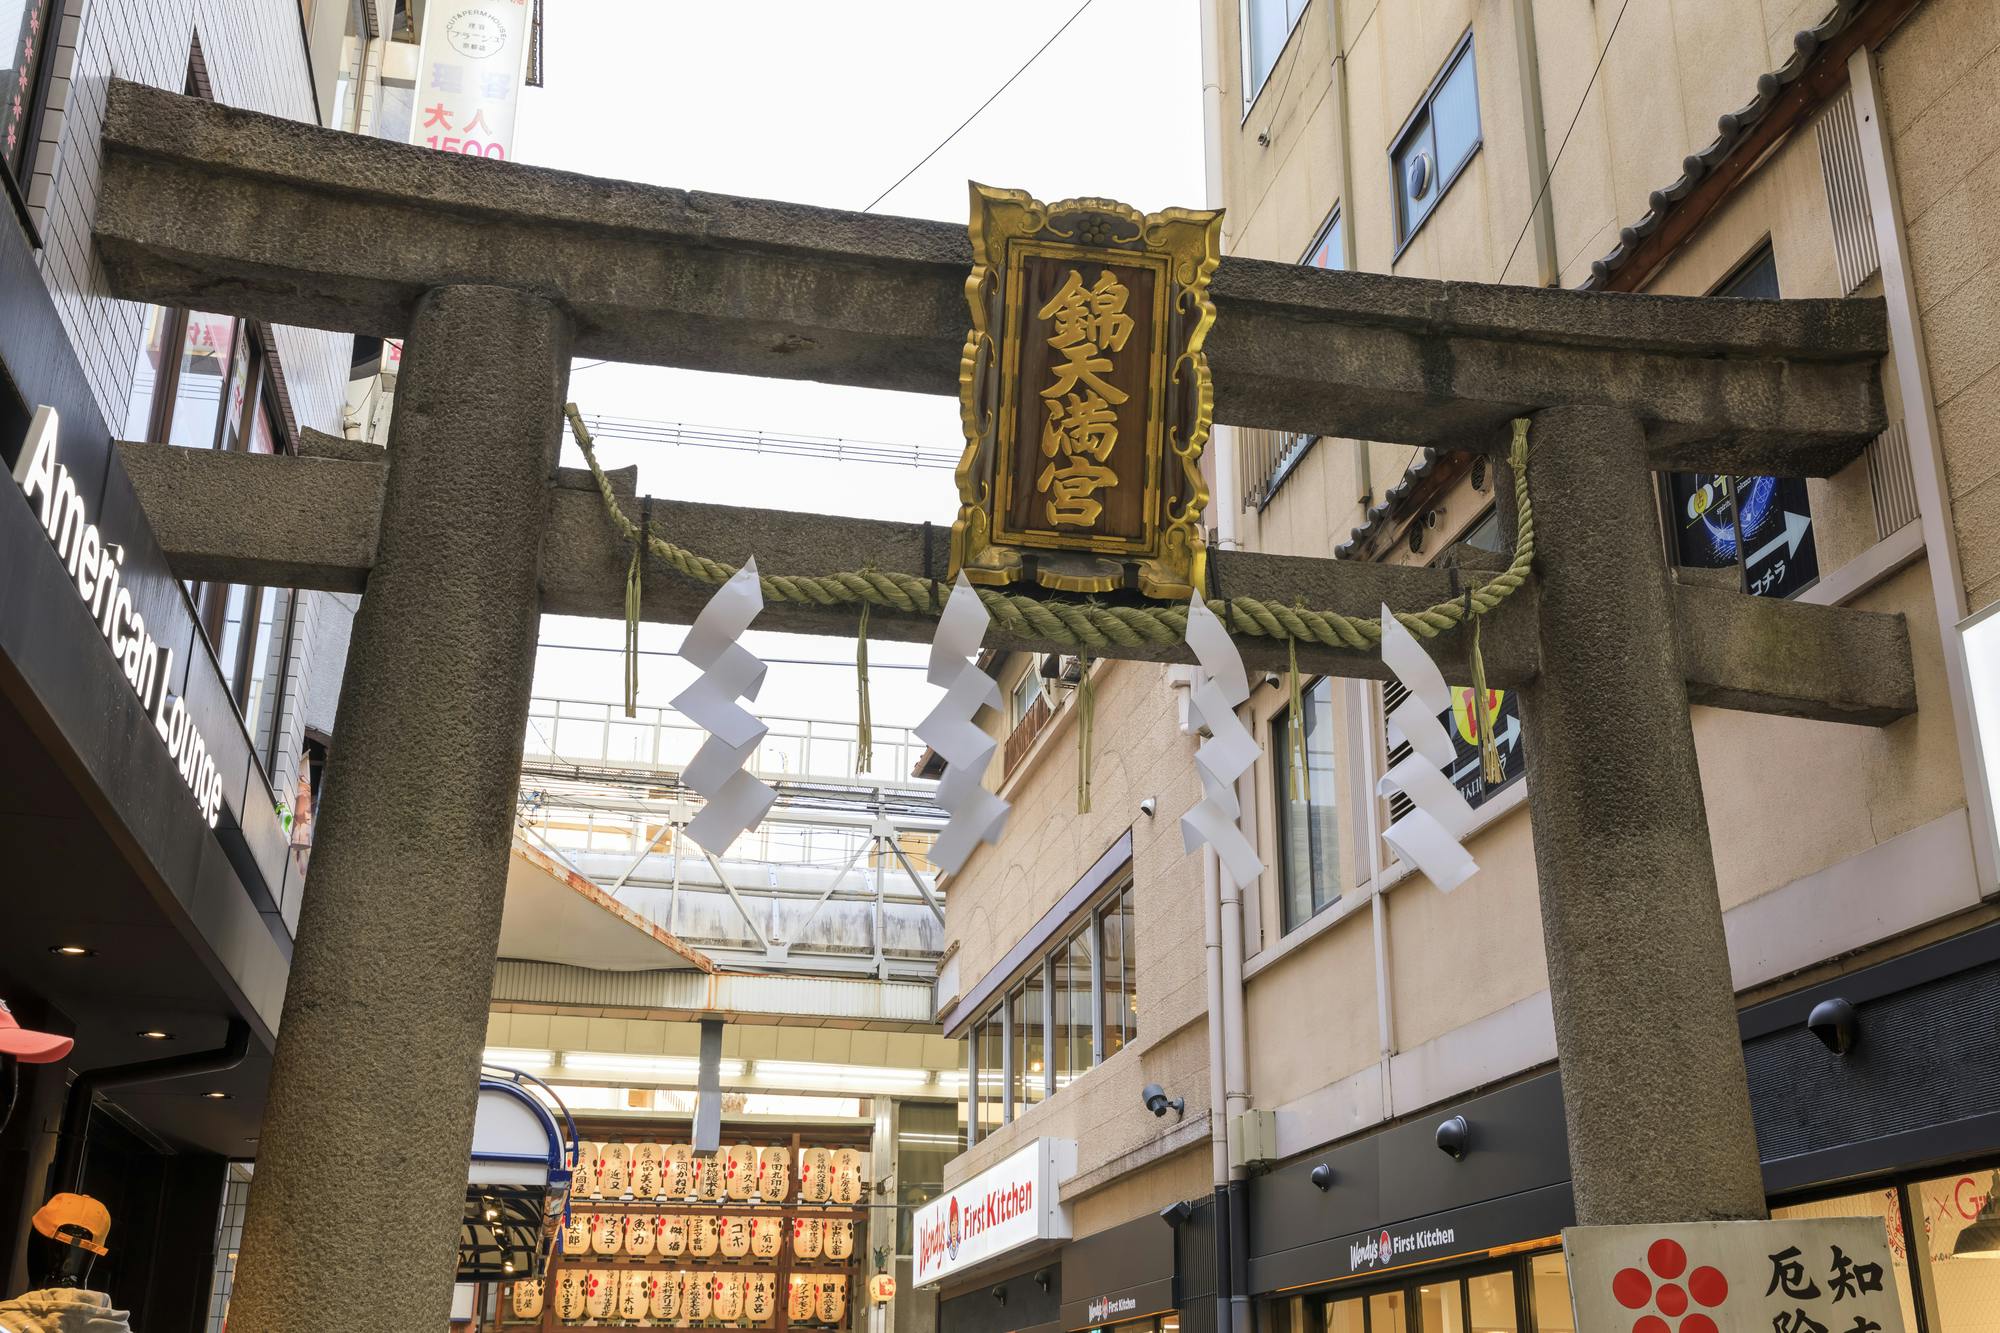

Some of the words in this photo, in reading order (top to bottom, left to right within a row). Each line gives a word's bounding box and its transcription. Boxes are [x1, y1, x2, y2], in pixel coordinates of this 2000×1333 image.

[423, 103, 492, 136] 大人
[1037, 269, 1135, 527] 錦天満宮
[1750, 559, 1786, 596] コチラ
[22, 406, 158, 710] American
[155, 648, 223, 829] Lounge
[609, 1169, 622, 1190] 近又
[964, 1199, 985, 1240] First
[986, 1178, 1033, 1228] Kitchen
[1349, 1235, 1379, 1273] Wendy's
[1393, 1233, 1416, 1255] First
[1415, 1227, 1456, 1250] Kitchen
[1118, 1297, 1137, 1312] Kitchen
